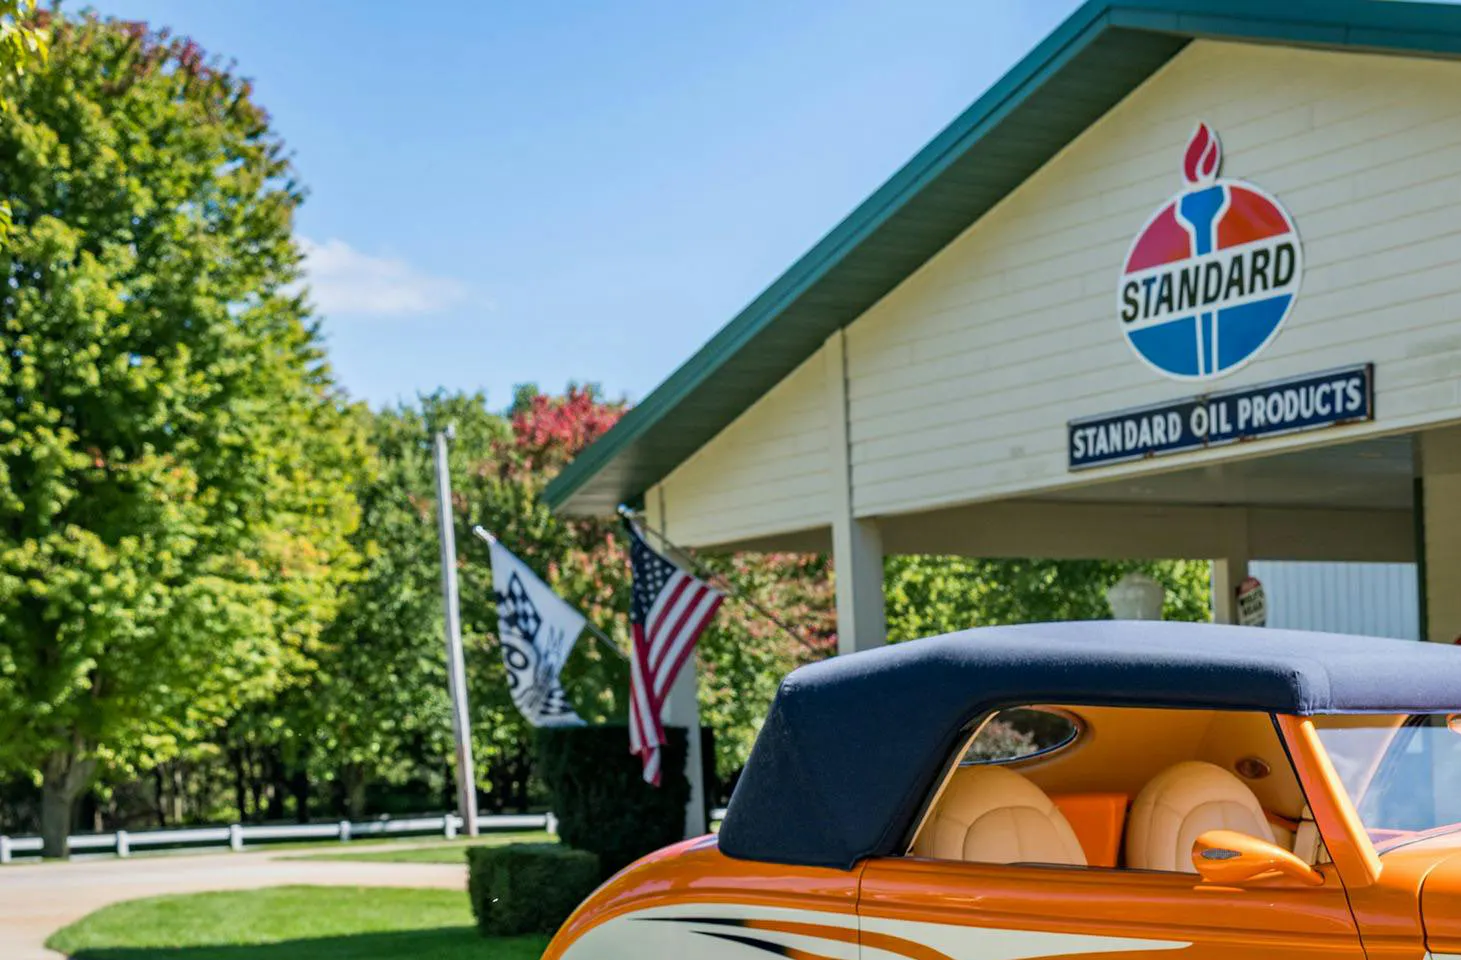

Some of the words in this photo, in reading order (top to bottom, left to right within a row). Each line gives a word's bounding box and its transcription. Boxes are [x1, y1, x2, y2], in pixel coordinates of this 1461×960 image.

[1121, 242, 1296, 323] STANDARD
[1073, 411, 1182, 459] STANDARD
[1190, 402, 1232, 437] OIL
[1238, 378, 1361, 431] PRODUCTS
